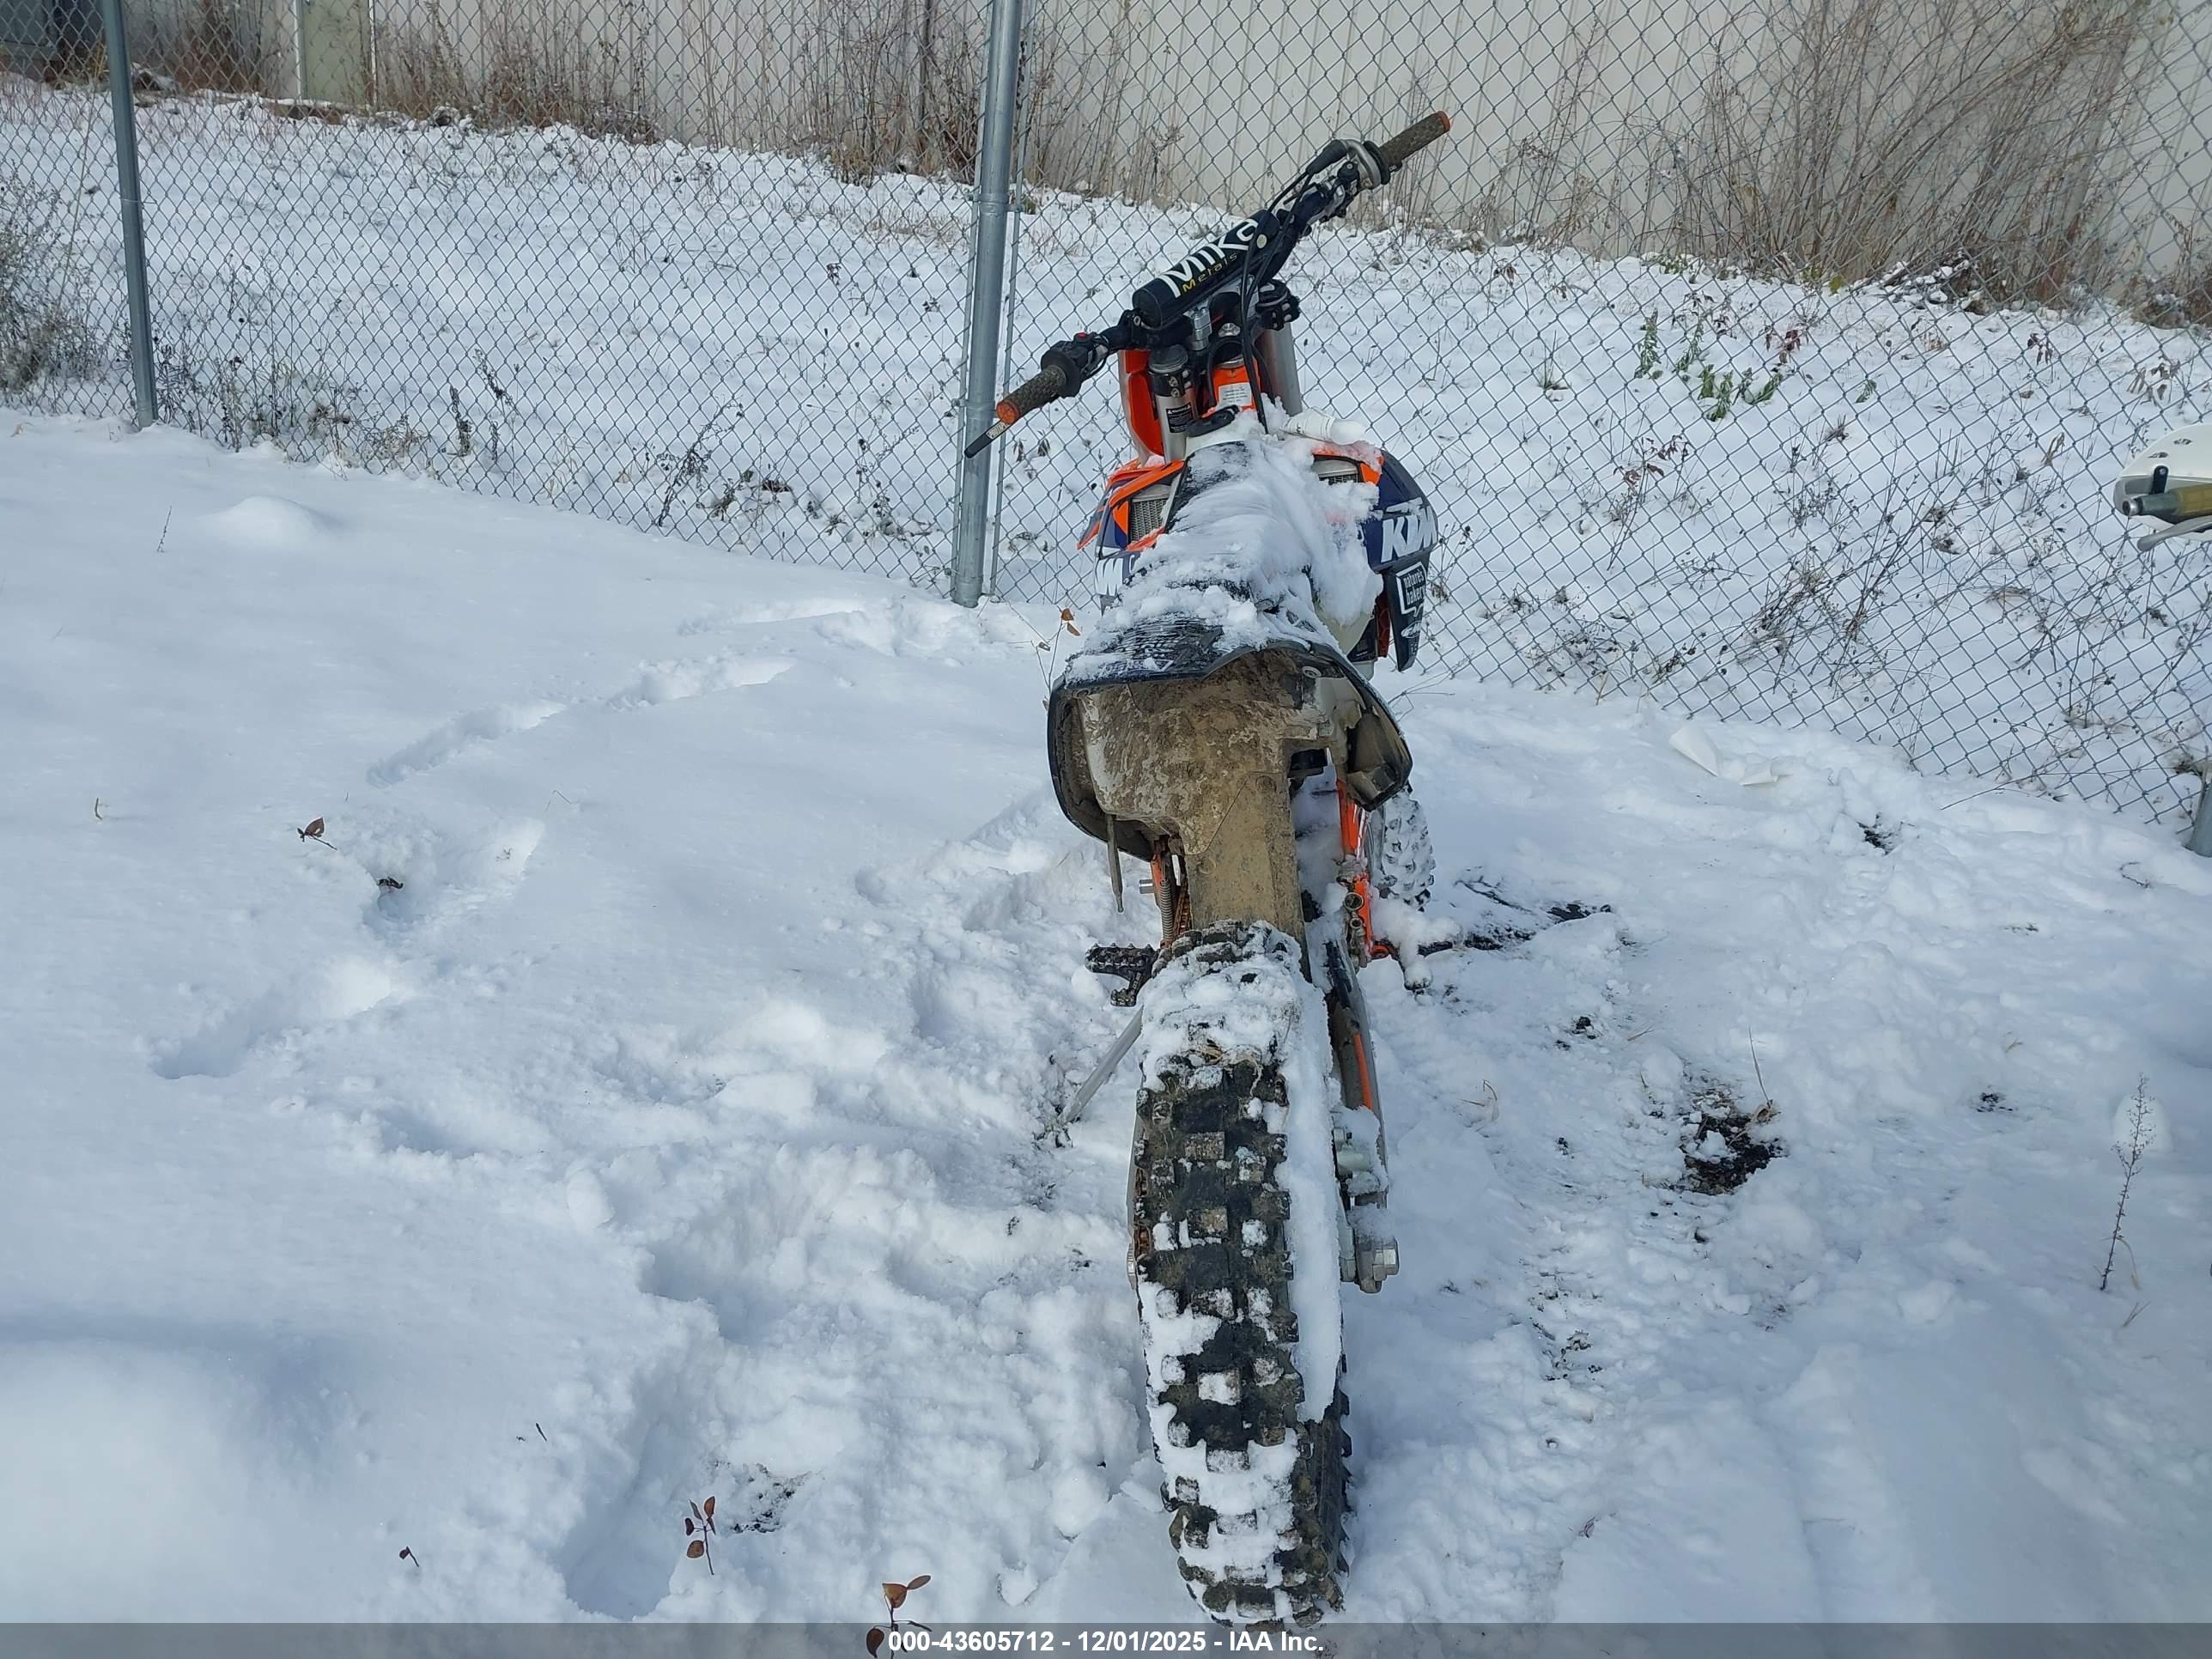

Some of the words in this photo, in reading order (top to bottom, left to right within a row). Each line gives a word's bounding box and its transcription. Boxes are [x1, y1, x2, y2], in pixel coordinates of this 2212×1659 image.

[1182, 253, 1237, 293] Metals
[1381, 497, 1437, 562] KTM
[1406, 584, 1425, 605] bakery
